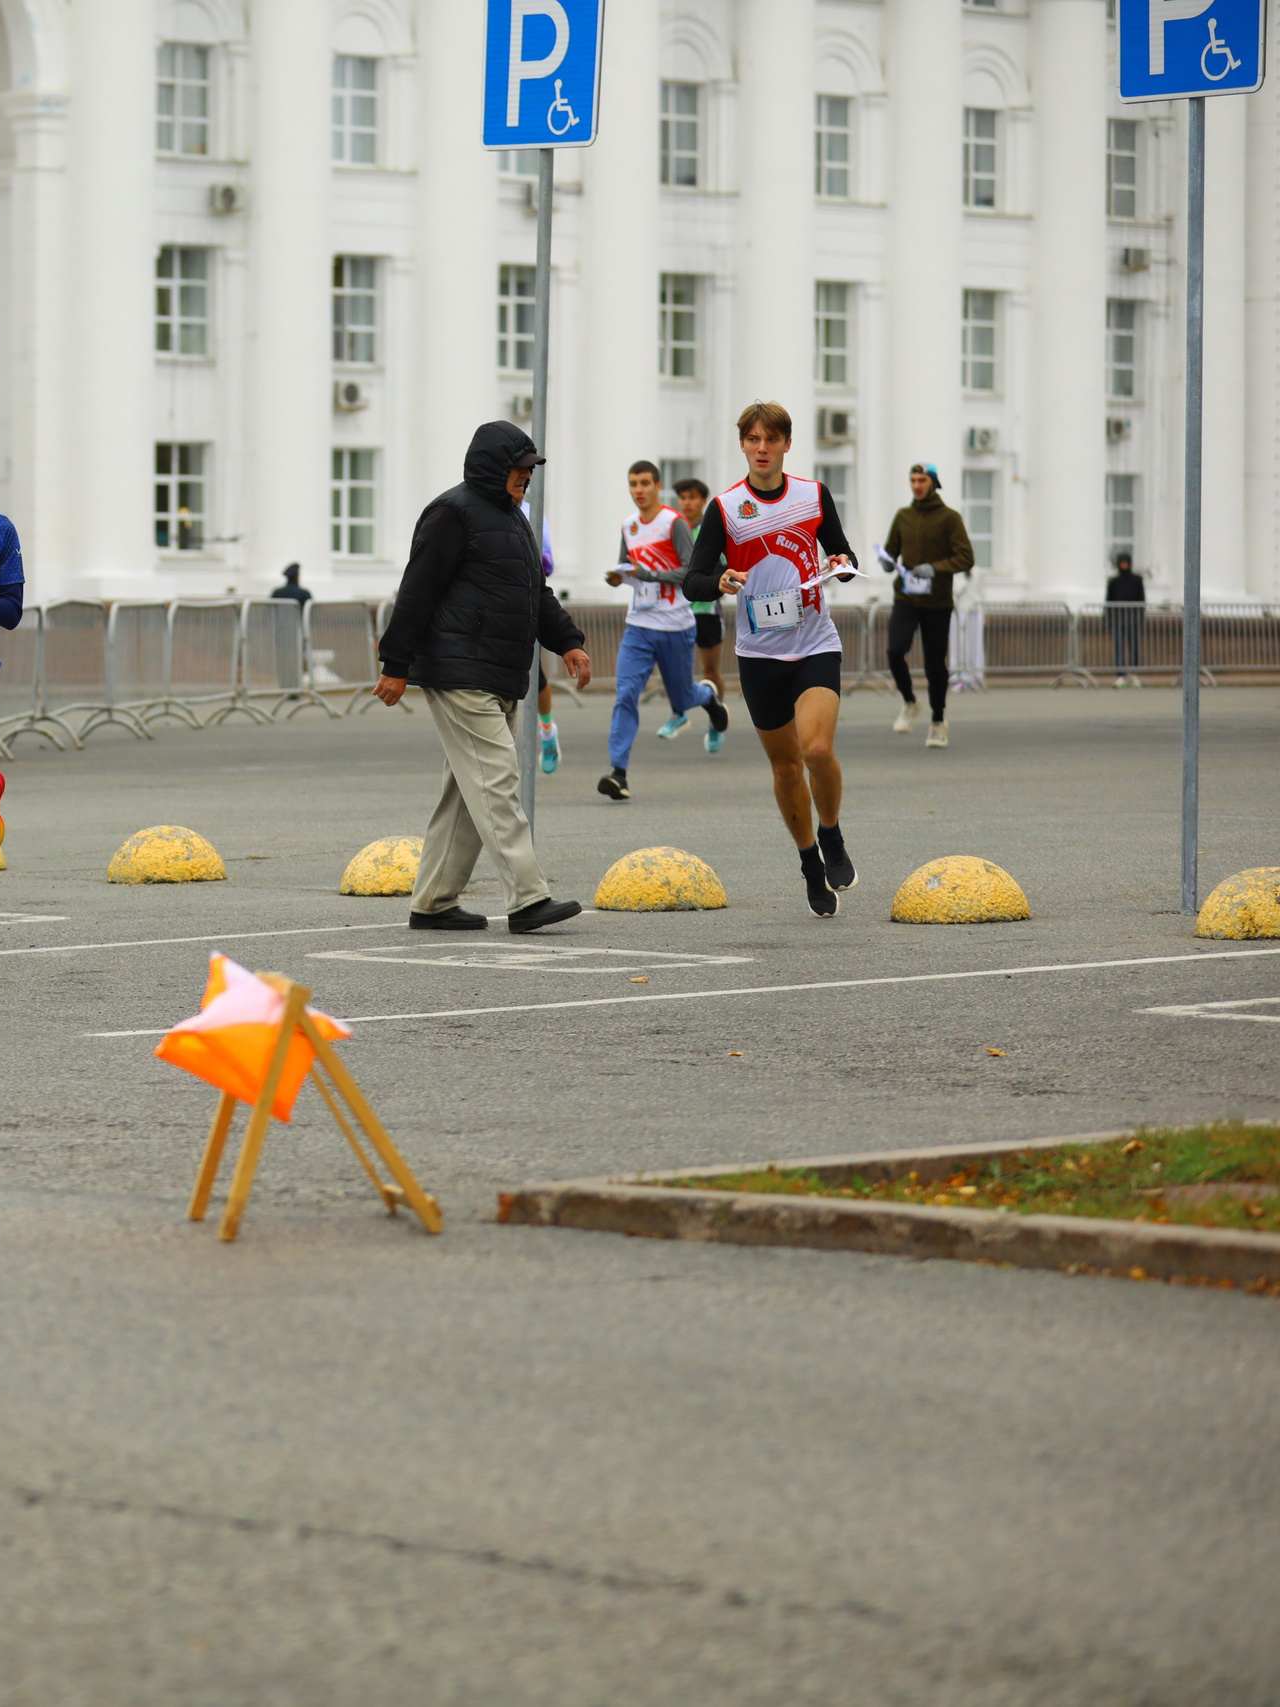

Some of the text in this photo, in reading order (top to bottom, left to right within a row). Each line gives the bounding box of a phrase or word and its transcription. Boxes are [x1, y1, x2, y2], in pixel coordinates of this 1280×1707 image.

[506, 0, 570, 127] P
[775, 534, 800, 553] Run
[798, 550, 813, 571] and
[765, 601, 785, 616] 1.1
